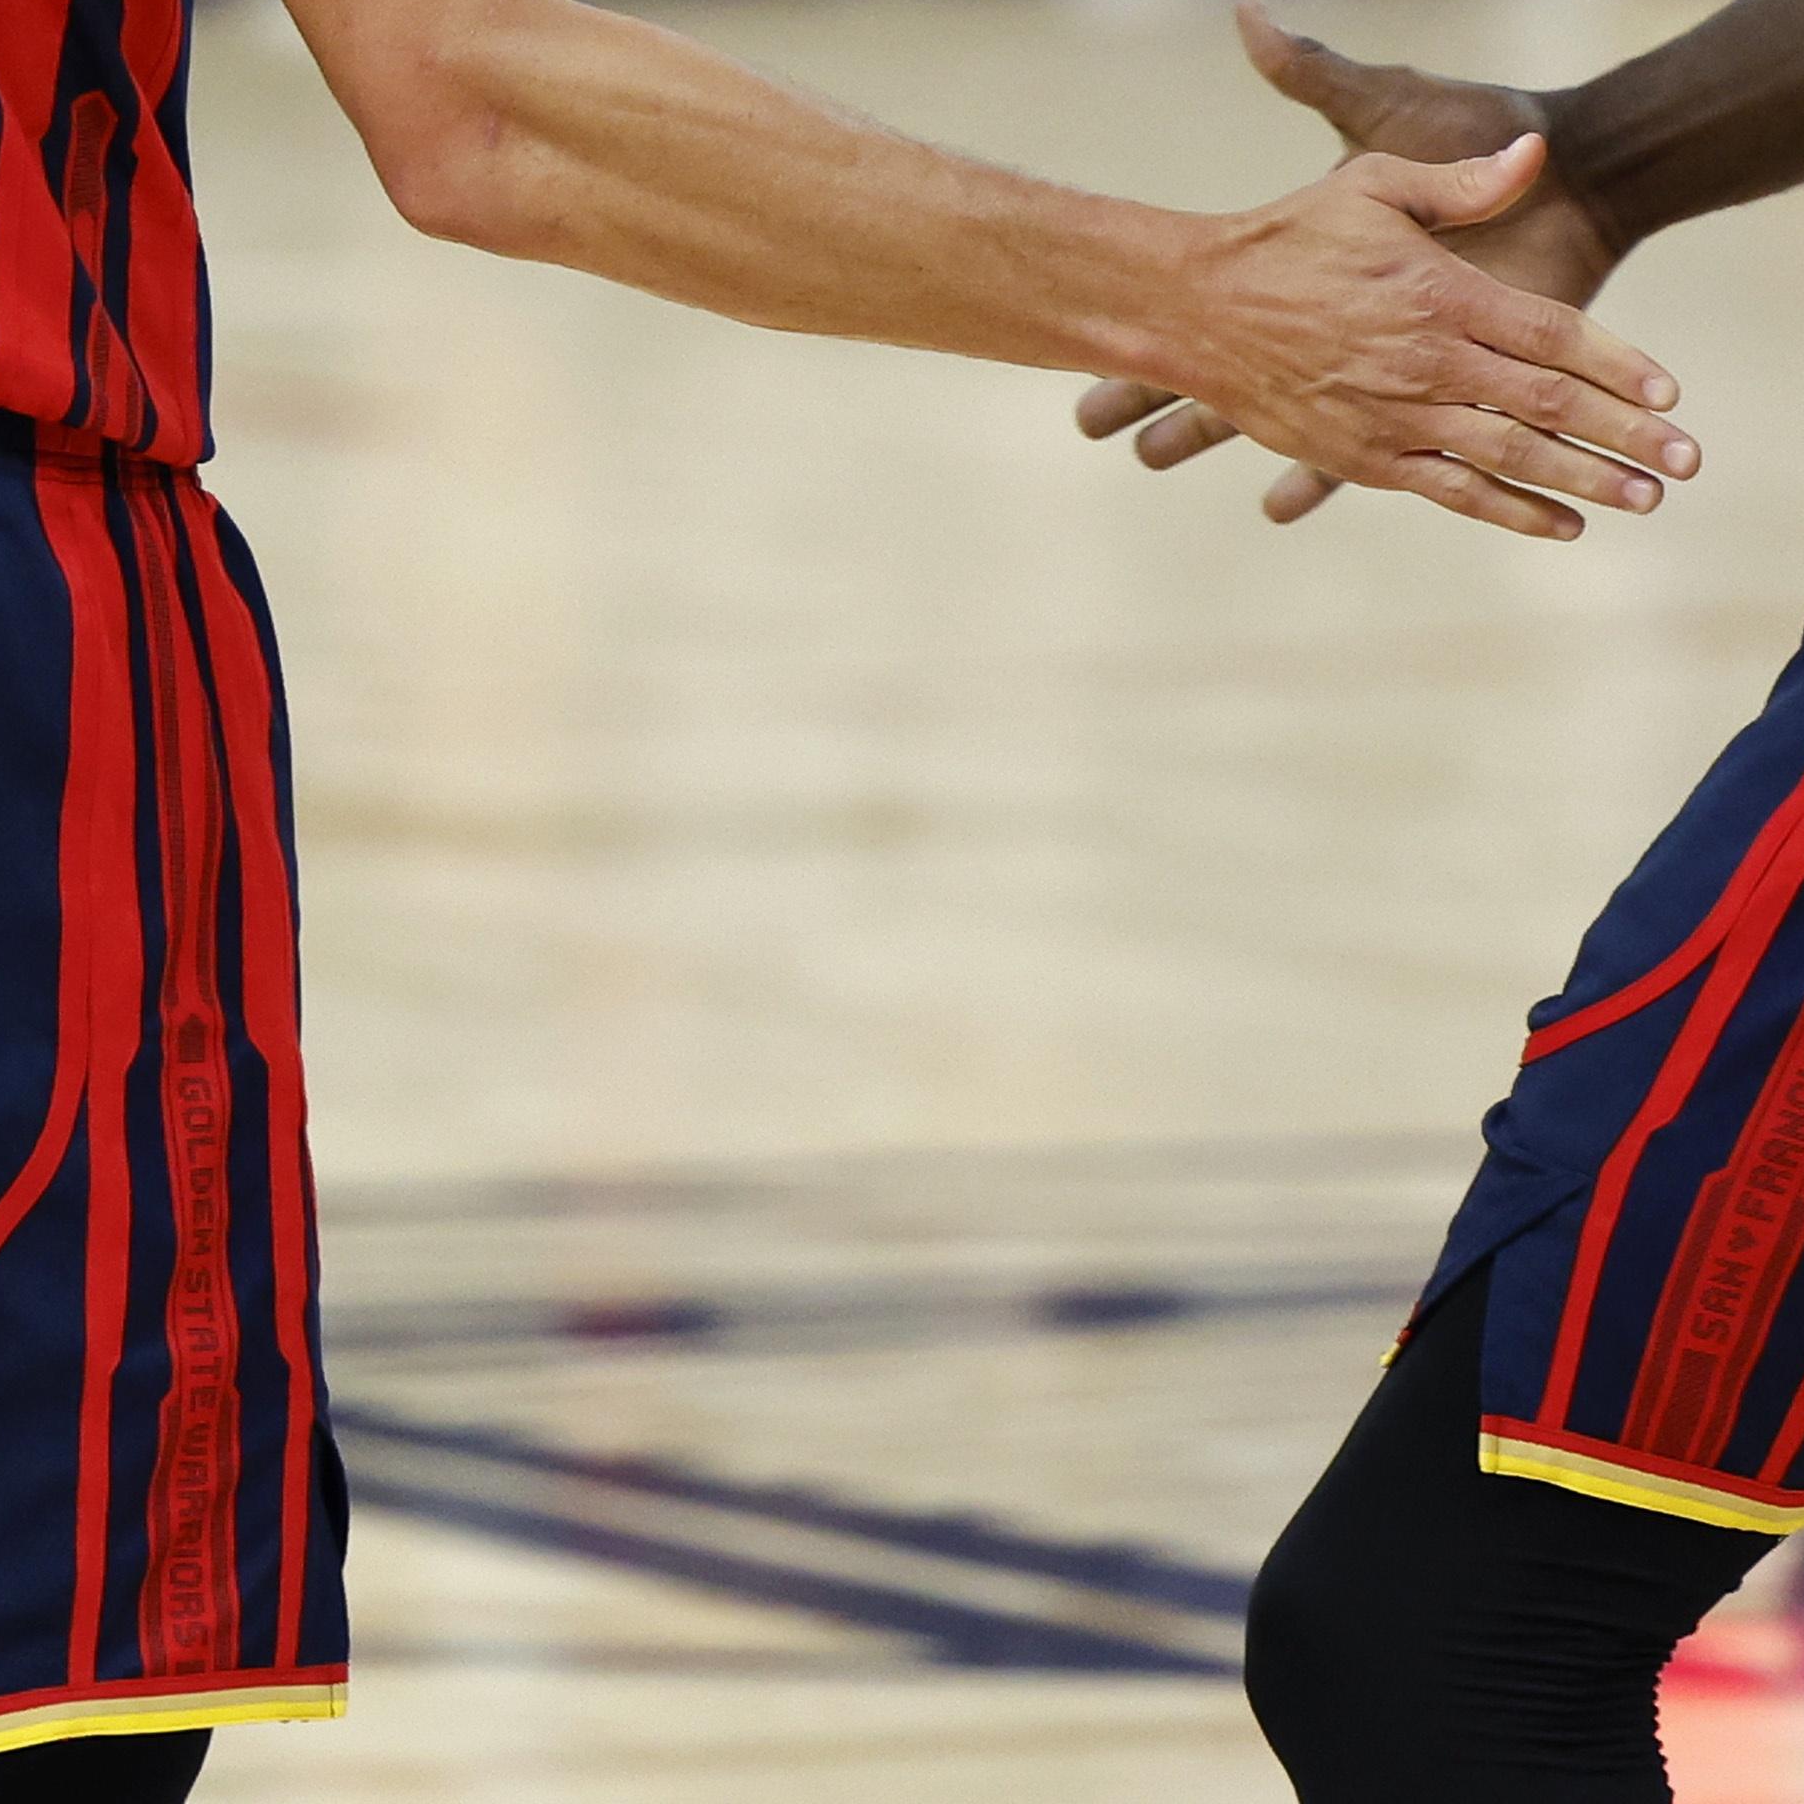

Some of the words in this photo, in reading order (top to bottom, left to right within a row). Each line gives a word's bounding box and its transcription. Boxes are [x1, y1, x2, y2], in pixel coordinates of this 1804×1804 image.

[177, 1076, 217, 1256] GOLDEN
[182, 1267, 223, 1413] STATE
[1690, 1256, 1754, 1346] SAN
[169, 1421, 209, 1648] WARRIORS
